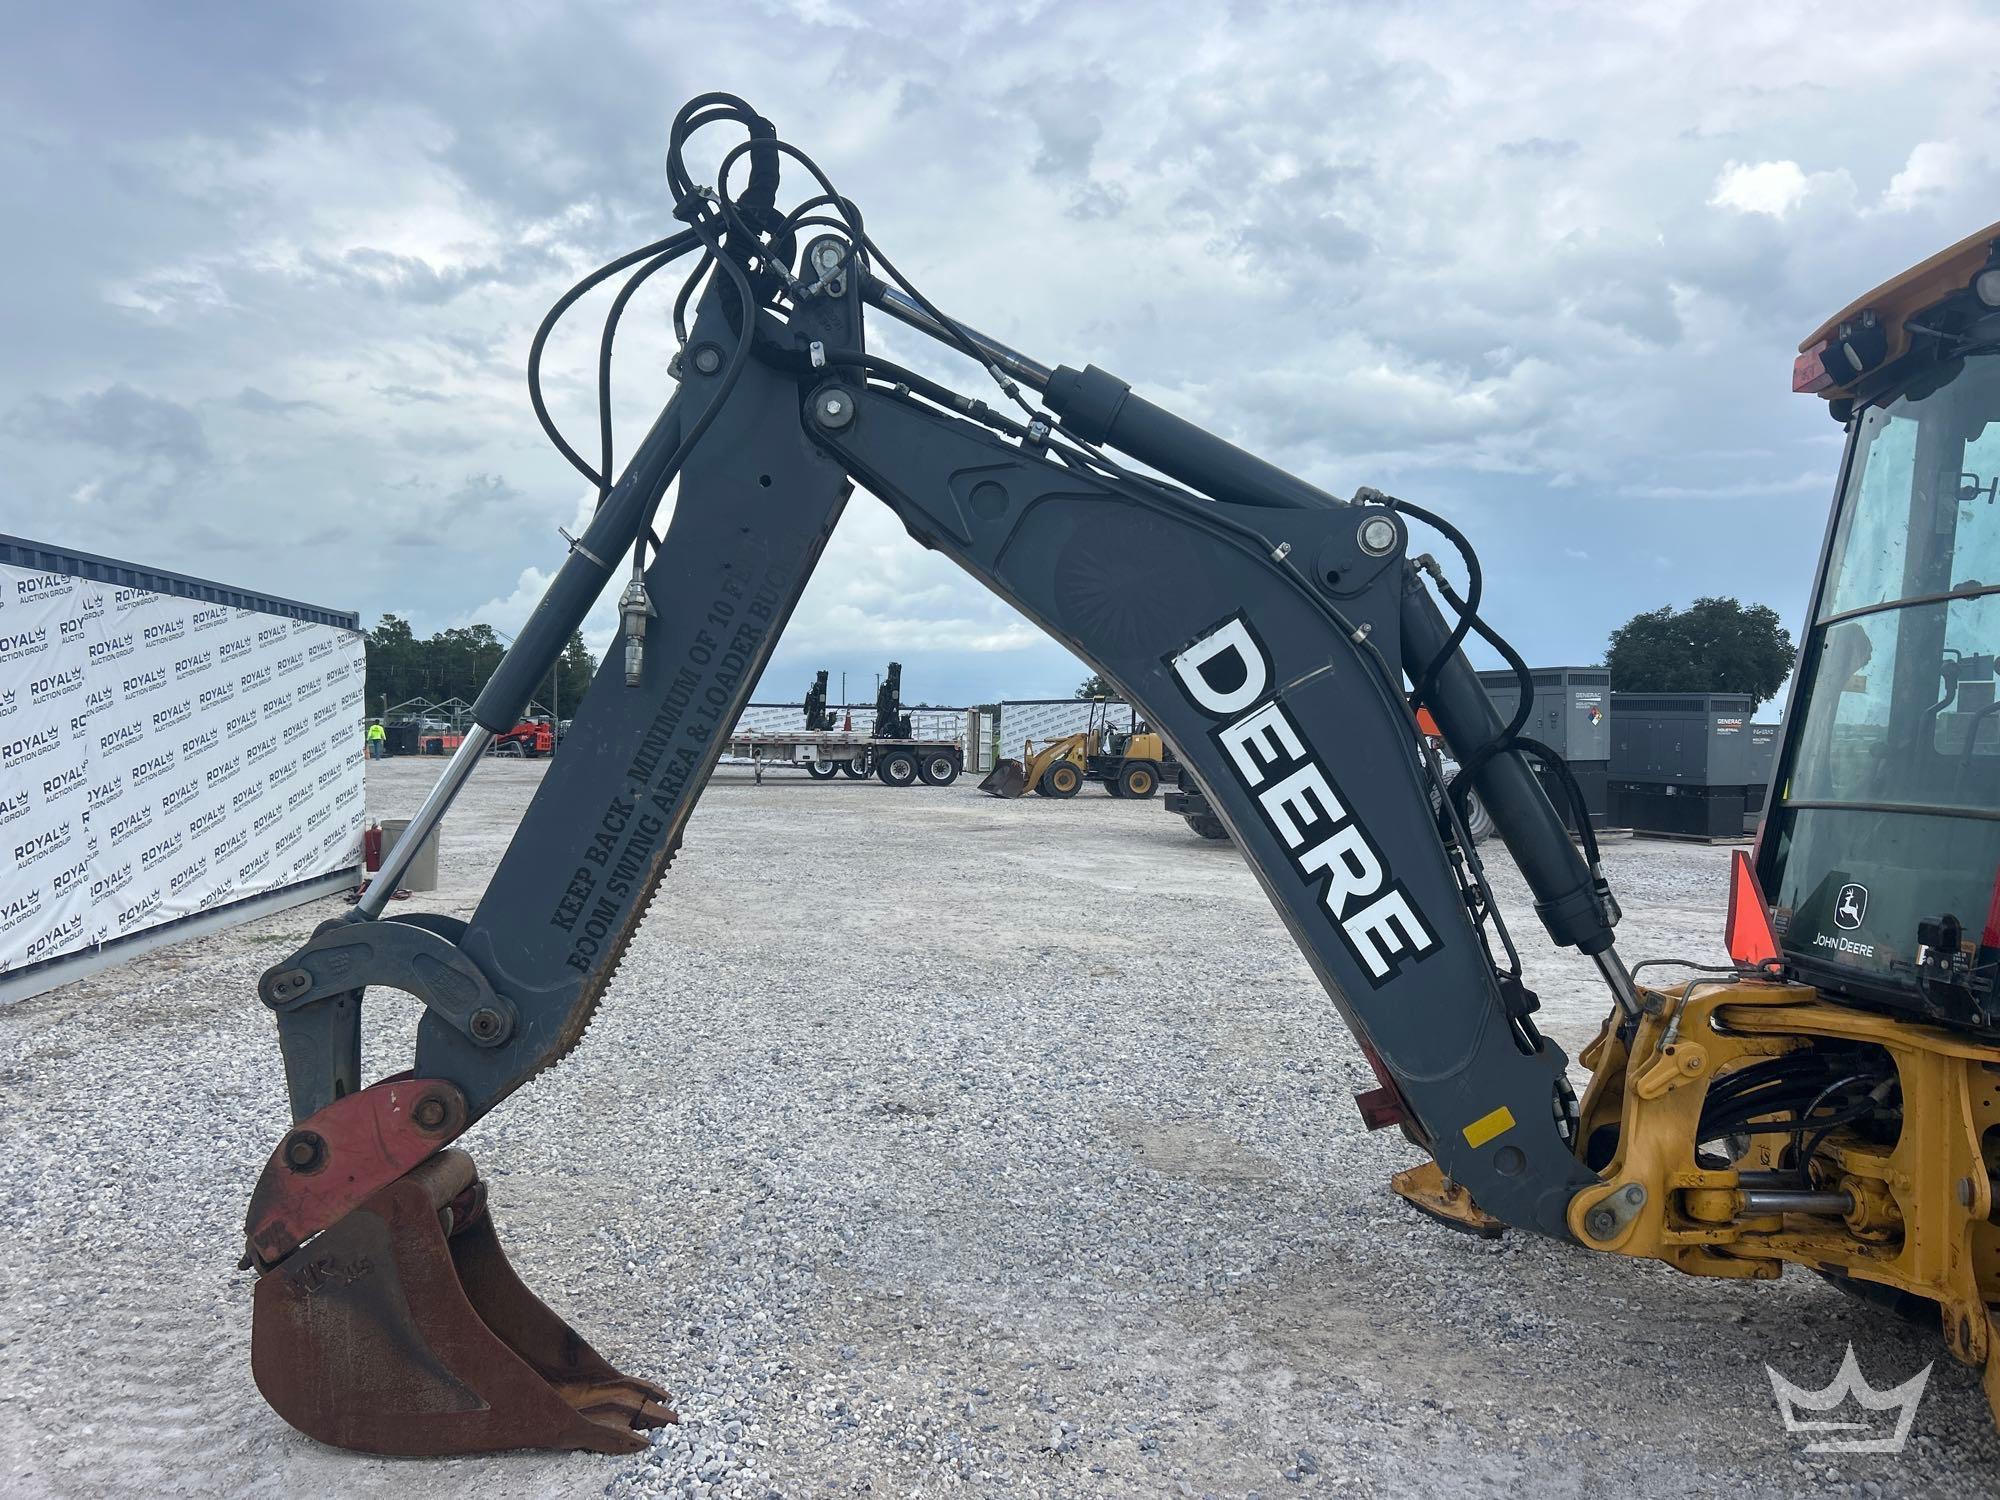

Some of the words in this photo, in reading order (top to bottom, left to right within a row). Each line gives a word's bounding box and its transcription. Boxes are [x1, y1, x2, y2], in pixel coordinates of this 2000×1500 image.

[18, 575, 60, 594] ROYAL
[192, 608, 220, 625] ROYAL
[144, 622, 176, 640] ROYAL
[258, 626, 282, 642] ROYAL
[25, 643, 48, 656] GROUP
[88, 637, 124, 658] ROYAL
[220, 640, 245, 656] ROYAL
[308, 641, 328, 656] ROYAL
[175, 654, 204, 673] ROYAL
[278, 654, 298, 670] ROYAL
[696, 622, 762, 722] LOADER
[30, 672, 72, 696] ROYAL
[123, 672, 158, 692] ROYAL
[240, 668, 265, 686] ROYAL
[326, 666, 345, 681] ROYAL
[200, 685, 227, 704] ROYAL
[297, 680, 317, 696] ROYAL
[263, 695, 286, 712] ROYAL
[314, 704, 332, 720] ROYAL
[152, 704, 184, 726] ROYAL
[226, 712, 250, 732] ROYAL
[100, 726, 134, 750] ROYAL
[283, 721, 303, 739] ROYAL
[331, 728, 350, 744] ROYAL
[686, 724, 714, 743] &
[2, 732, 48, 760] ROYAL
[182, 732, 210, 754] ROYAL
[247, 740, 270, 759] ROYAL
[302, 745, 322, 762] ROYAL
[132, 756, 166, 780] ROYAL
[206, 760, 234, 782] ROYAL
[269, 763, 292, 782] ROYAL
[318, 768, 337, 785] ROYAL
[550, 866, 598, 932] KEEP
[584, 796, 635, 868] BACK
[626, 666, 702, 785] MINIMUM
[688, 629, 718, 665] OF
[707, 600, 735, 628] 10
[43, 766, 82, 794] ROYAL
[651, 748, 700, 815] AREA
[162, 784, 191, 808] ROYAL
[232, 784, 257, 807] ROYAL
[288, 787, 308, 806] ROYAL
[335, 787, 353, 805] ROYAL
[1171, 618, 1432, 978] DEERE
[4, 806, 31, 824] GROUP
[110, 812, 142, 838] ROYAL
[190, 809, 218, 833] ROYAL
[254, 809, 276, 830] ROYAL
[307, 808, 326, 827] ROYAL
[14, 829, 60, 860] ROYAL
[214, 834, 240, 858] ROYAL
[275, 830, 296, 852] ROYAL
[323, 828, 341, 847] ROYAL
[141, 837, 175, 864] ROYAL
[293, 850, 313, 872] ROYAL
[606, 814, 664, 898] SWING
[170, 862, 199, 890] ROYAL
[240, 855, 263, 879] ROYAL
[200, 884, 225, 909] ROYAL
[16, 904, 41, 924] GROUP
[118, 896, 154, 926] ROYAL
[26, 923, 70, 958] ROYAL
[566, 896, 622, 973] BOOM
[1812, 932, 1839, 950] JOHN
[1839, 936, 1874, 958] DEERE
